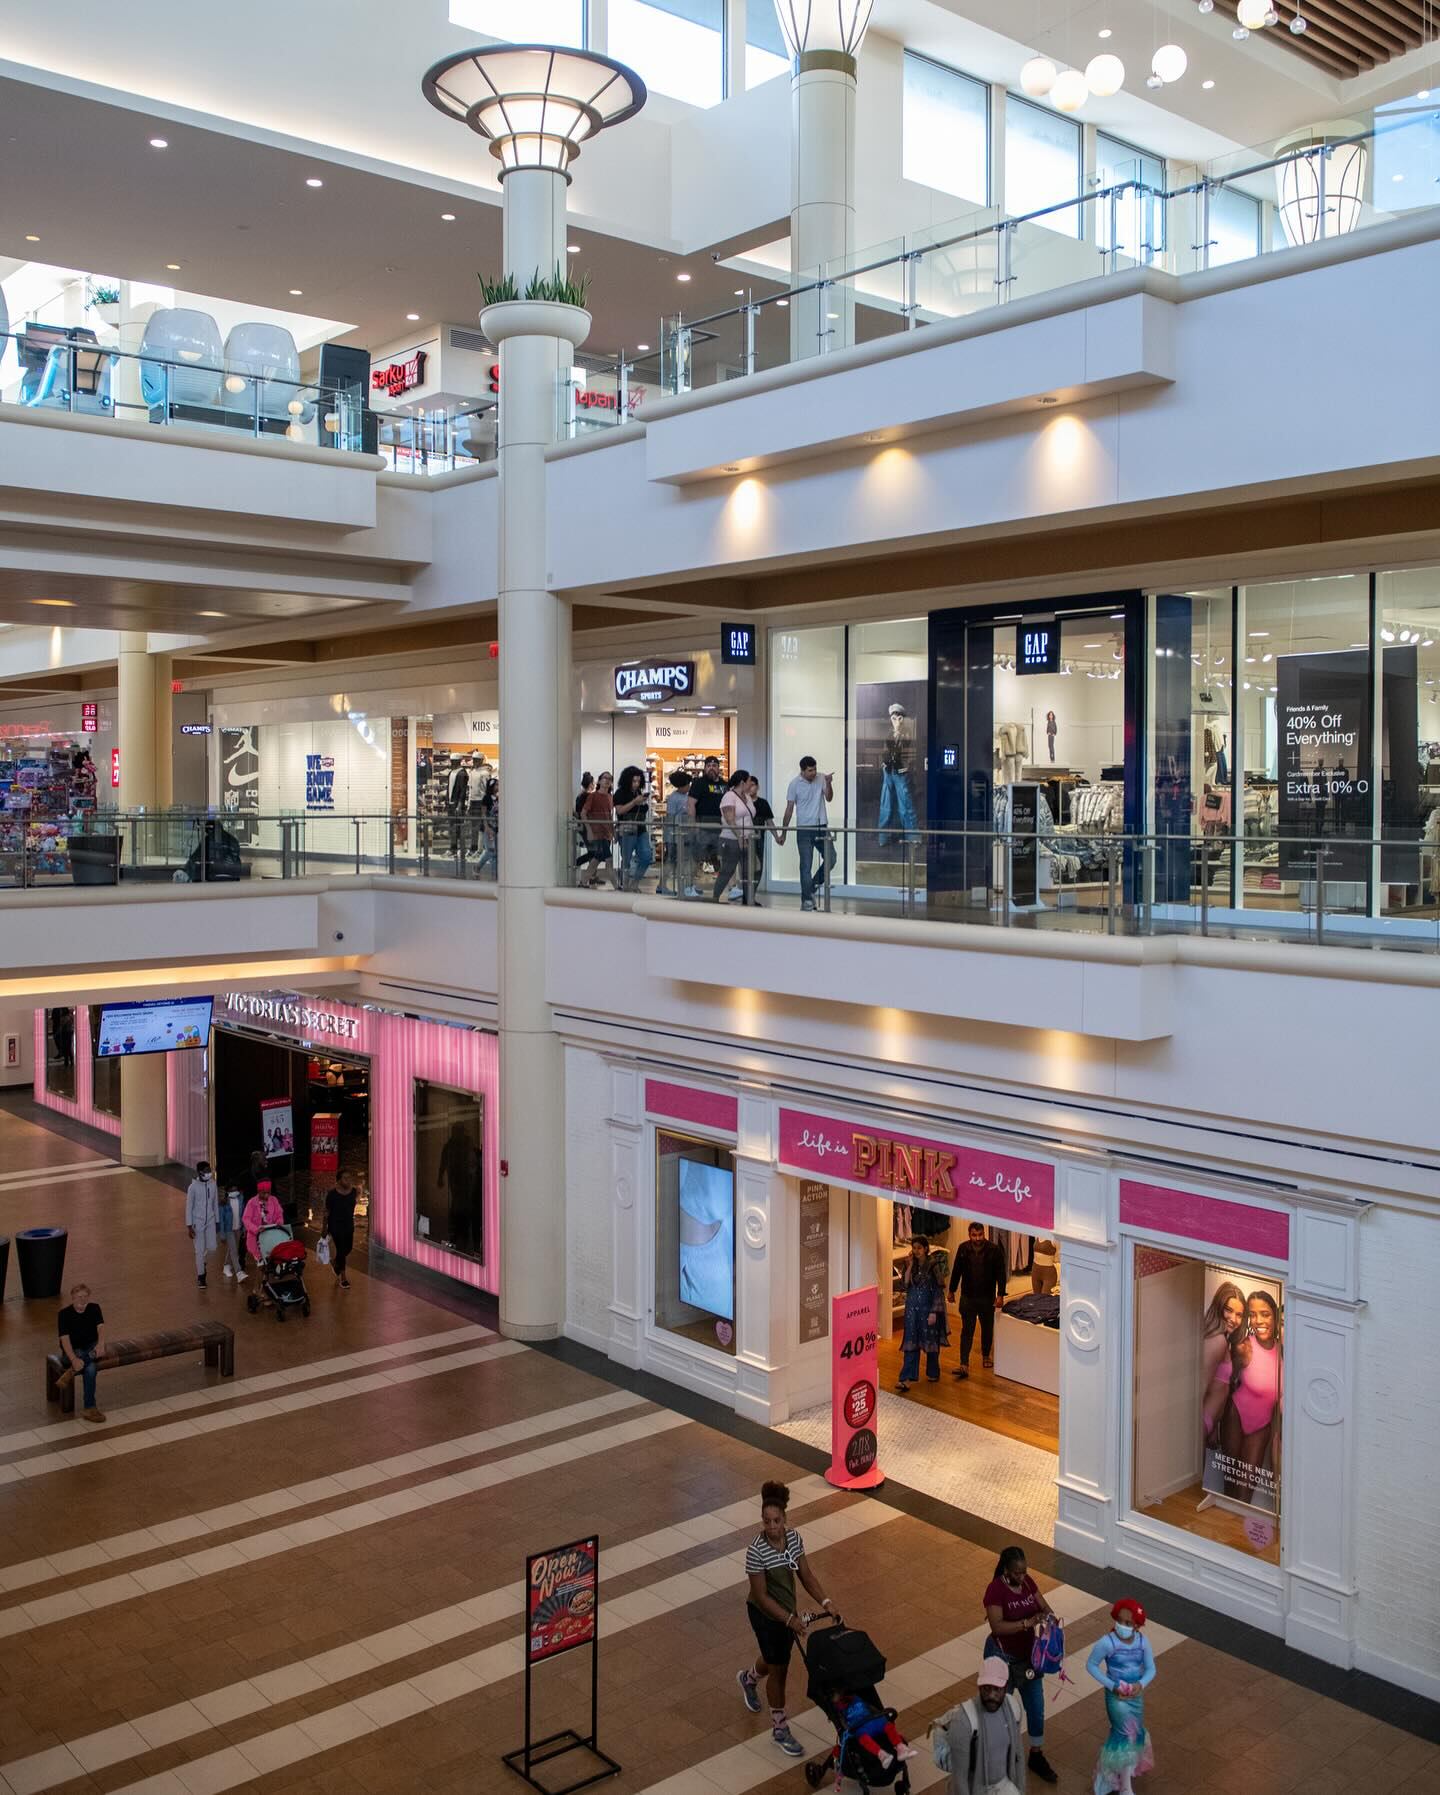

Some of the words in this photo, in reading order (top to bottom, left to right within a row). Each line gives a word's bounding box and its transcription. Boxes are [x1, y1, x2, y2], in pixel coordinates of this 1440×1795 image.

[372, 363, 406, 390] Sarku
[730, 631, 749, 650] GAP
[1025, 632, 1048, 656] GAP
[1025, 656, 1048, 664] KIDS
[616, 665, 689, 695] CHAMPS
[640, 691, 662, 700] SPORTS
[472, 720, 491, 732] KIDS
[1287, 715, 1316, 730] 40%
[1321, 714, 1342, 729] Off
[655, 727, 672, 737] KIDS
[1287, 781, 1320, 794] Extra
[1325, 780, 1353, 794] 10%
[301, 1007, 359, 1039] SECRET
[798, 1129, 832, 1156] life
[834, 1141, 848, 1155] is
[852, 1133, 957, 1200] PINK
[969, 1171, 986, 1187] is
[988, 1172, 1032, 1203] life
[846, 1305, 870, 1319] APPAREL
[1211, 1461, 1247, 1479] STRETCH
[1214, 1452, 1236, 1465] MEET
[1238, 1460, 1253, 1472] THE
[1254, 1466, 1273, 1479] NEW
[531, 1552, 578, 1584] Open
